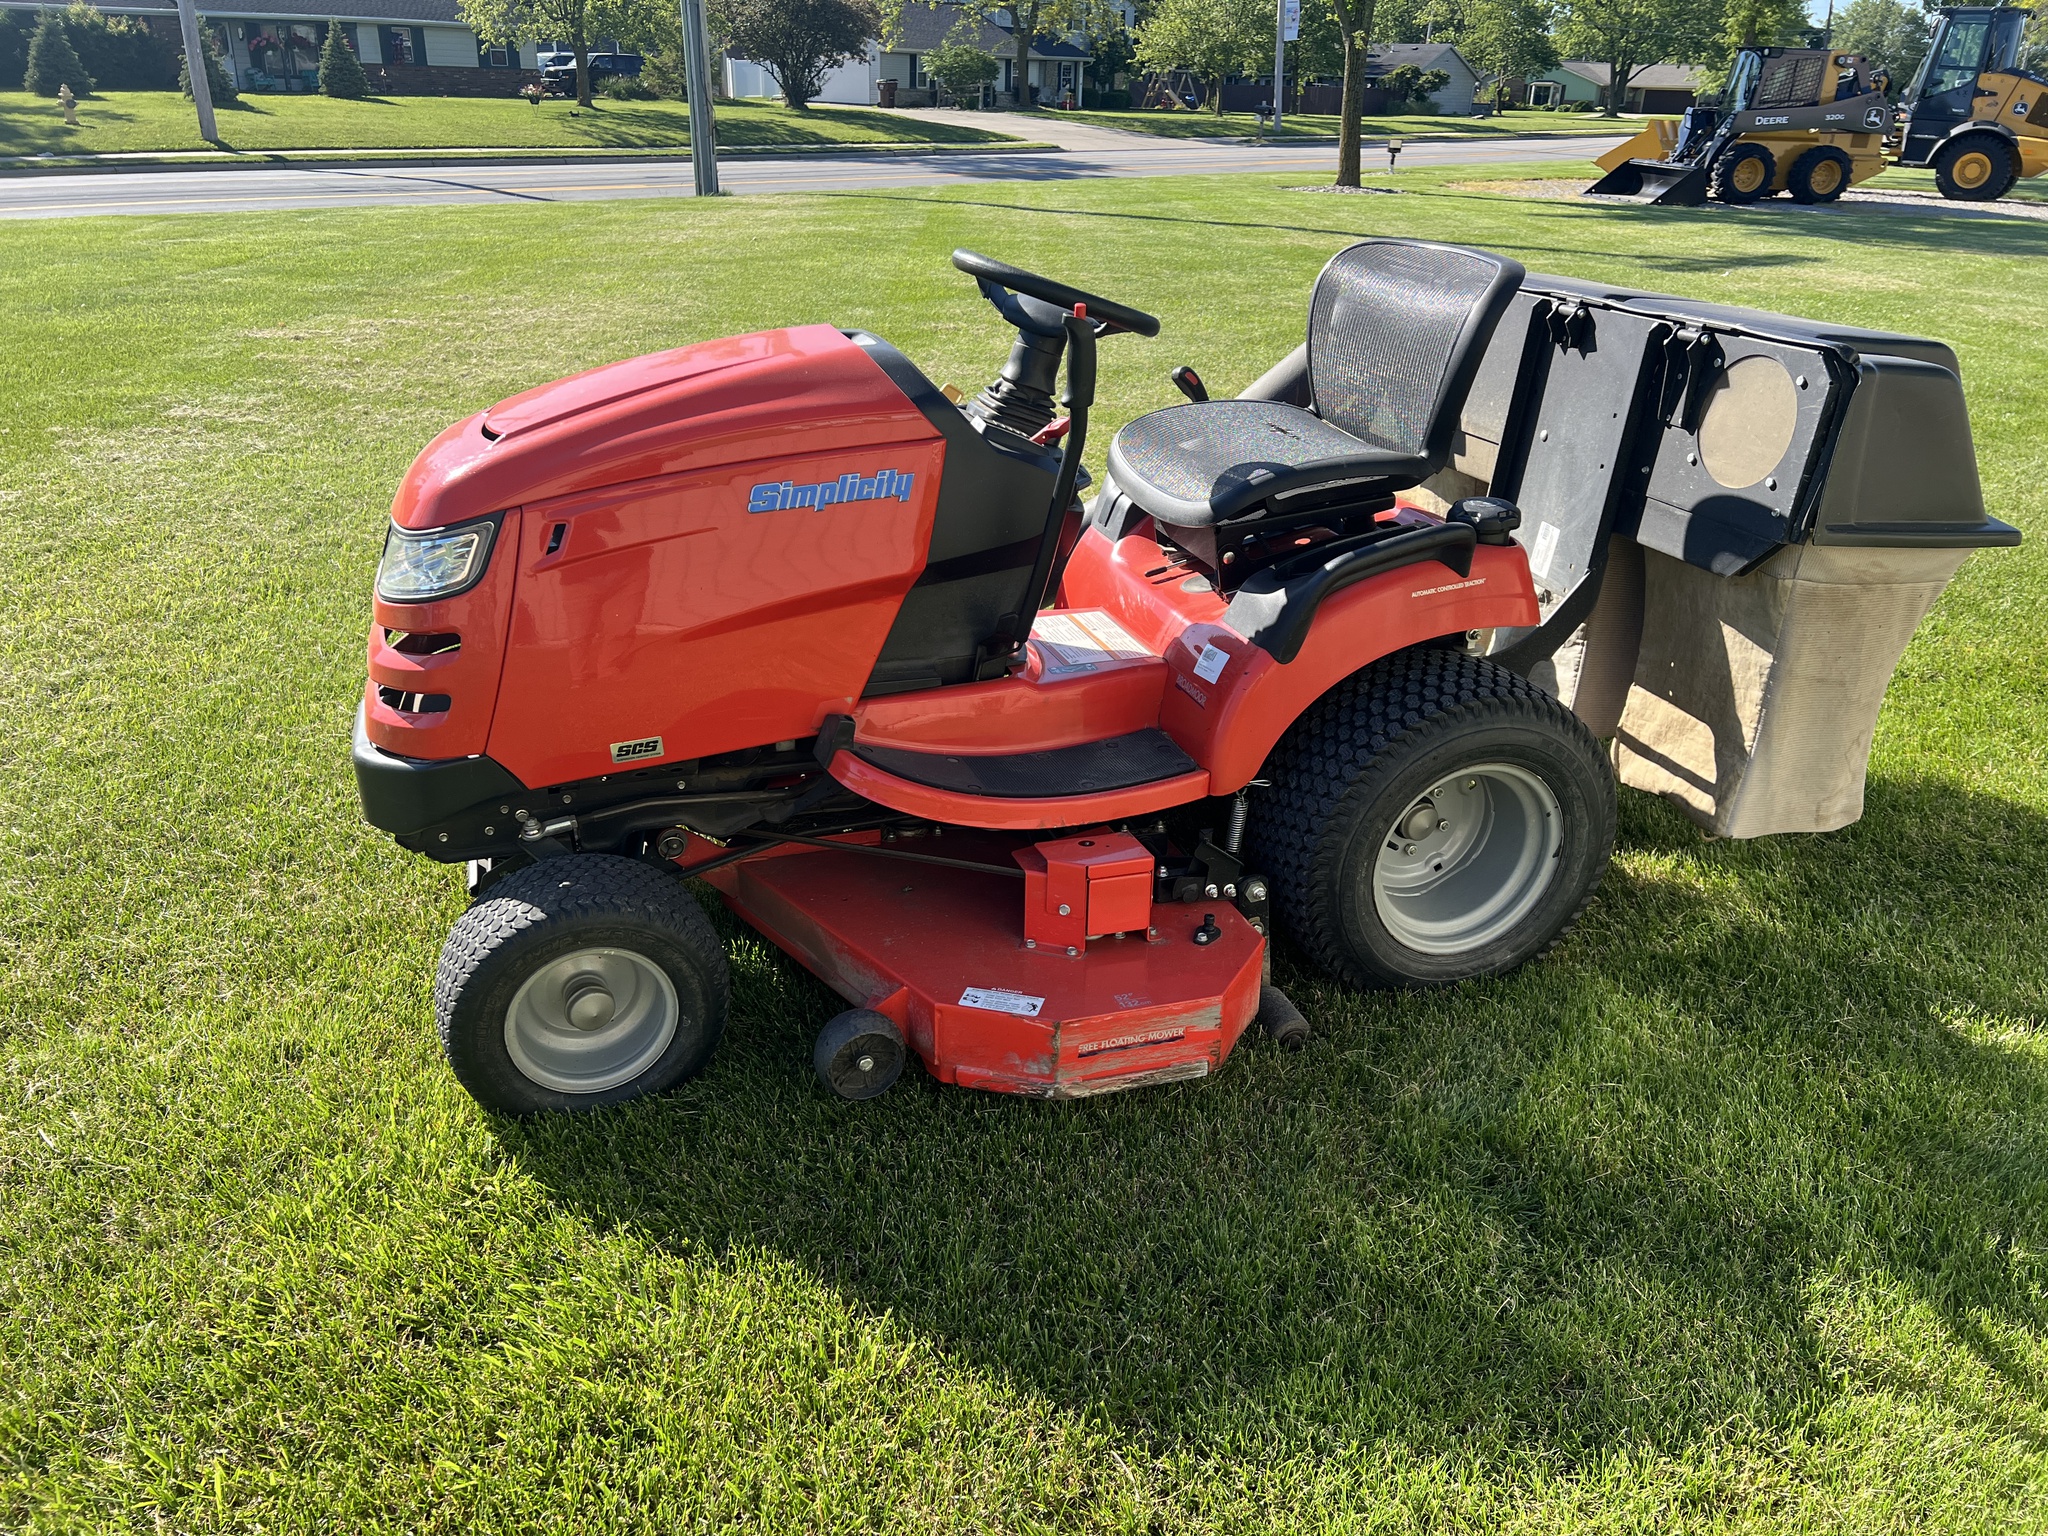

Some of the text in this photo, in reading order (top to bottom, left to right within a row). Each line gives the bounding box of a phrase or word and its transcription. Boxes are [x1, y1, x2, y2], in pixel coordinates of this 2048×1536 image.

[1755, 116, 1789, 126] DEERE
[748, 469, 915, 513] Simplicity
[1411, 588, 1437, 598] AUTOMATIC
[1437, 582, 1464, 593] CONTROLLED
[616, 740, 659, 758] SCS
[997, 987, 1023, 995] DANGER
[1078, 1027, 1185, 1053] FREE FLOATING MOWER
